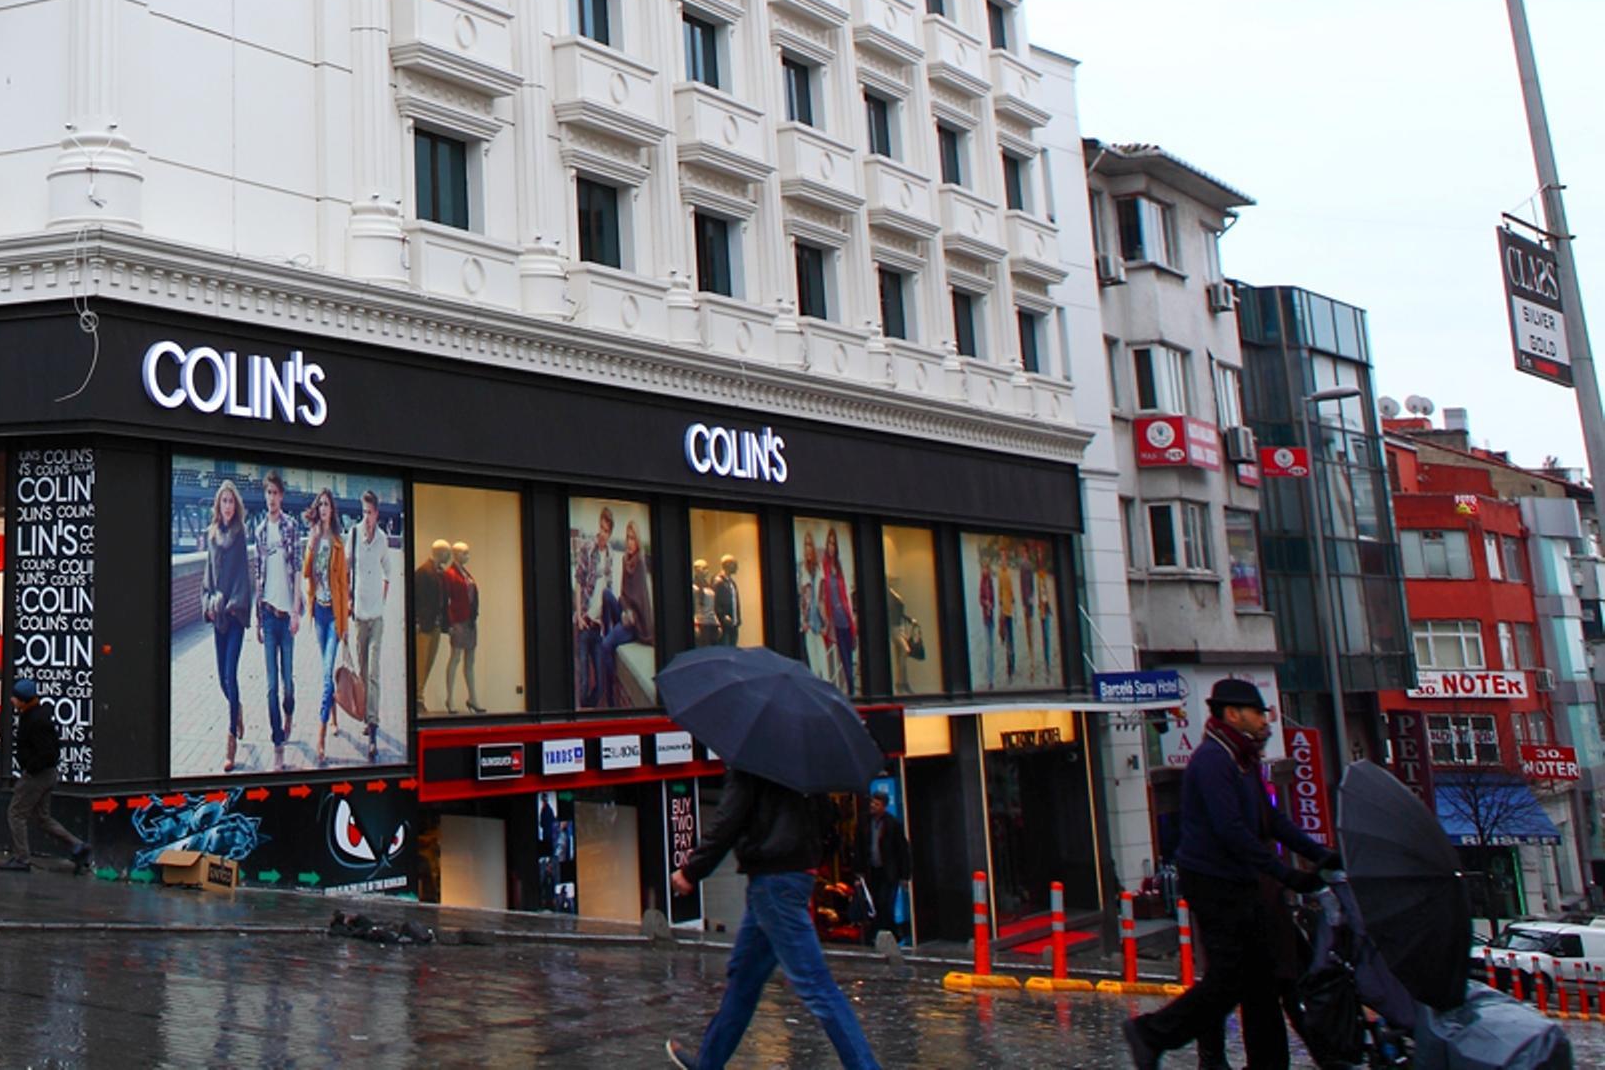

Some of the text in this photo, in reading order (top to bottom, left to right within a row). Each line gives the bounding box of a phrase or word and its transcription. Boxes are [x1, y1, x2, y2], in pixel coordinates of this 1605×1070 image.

[1522, 305, 1557, 332] SILVER
[1529, 334, 1557, 357] GOLD
[142, 340, 328, 427] COLIN'S
[684, 423, 788, 483] COLIN'S
[17, 520, 78, 557] LIN'S
[20, 613, 69, 631] COLIN'S
[1099, 679, 1178, 699] Barceló Saray Hotel
[1442, 673, 1524, 695] NOTER
[1523, 760, 1579, 778] NOTER
[1290, 731, 1322, 830] ACCORD
[671, 797, 692, 815] BUY
[671, 814, 694, 832] TWO
[674, 831, 693, 850] PAY
